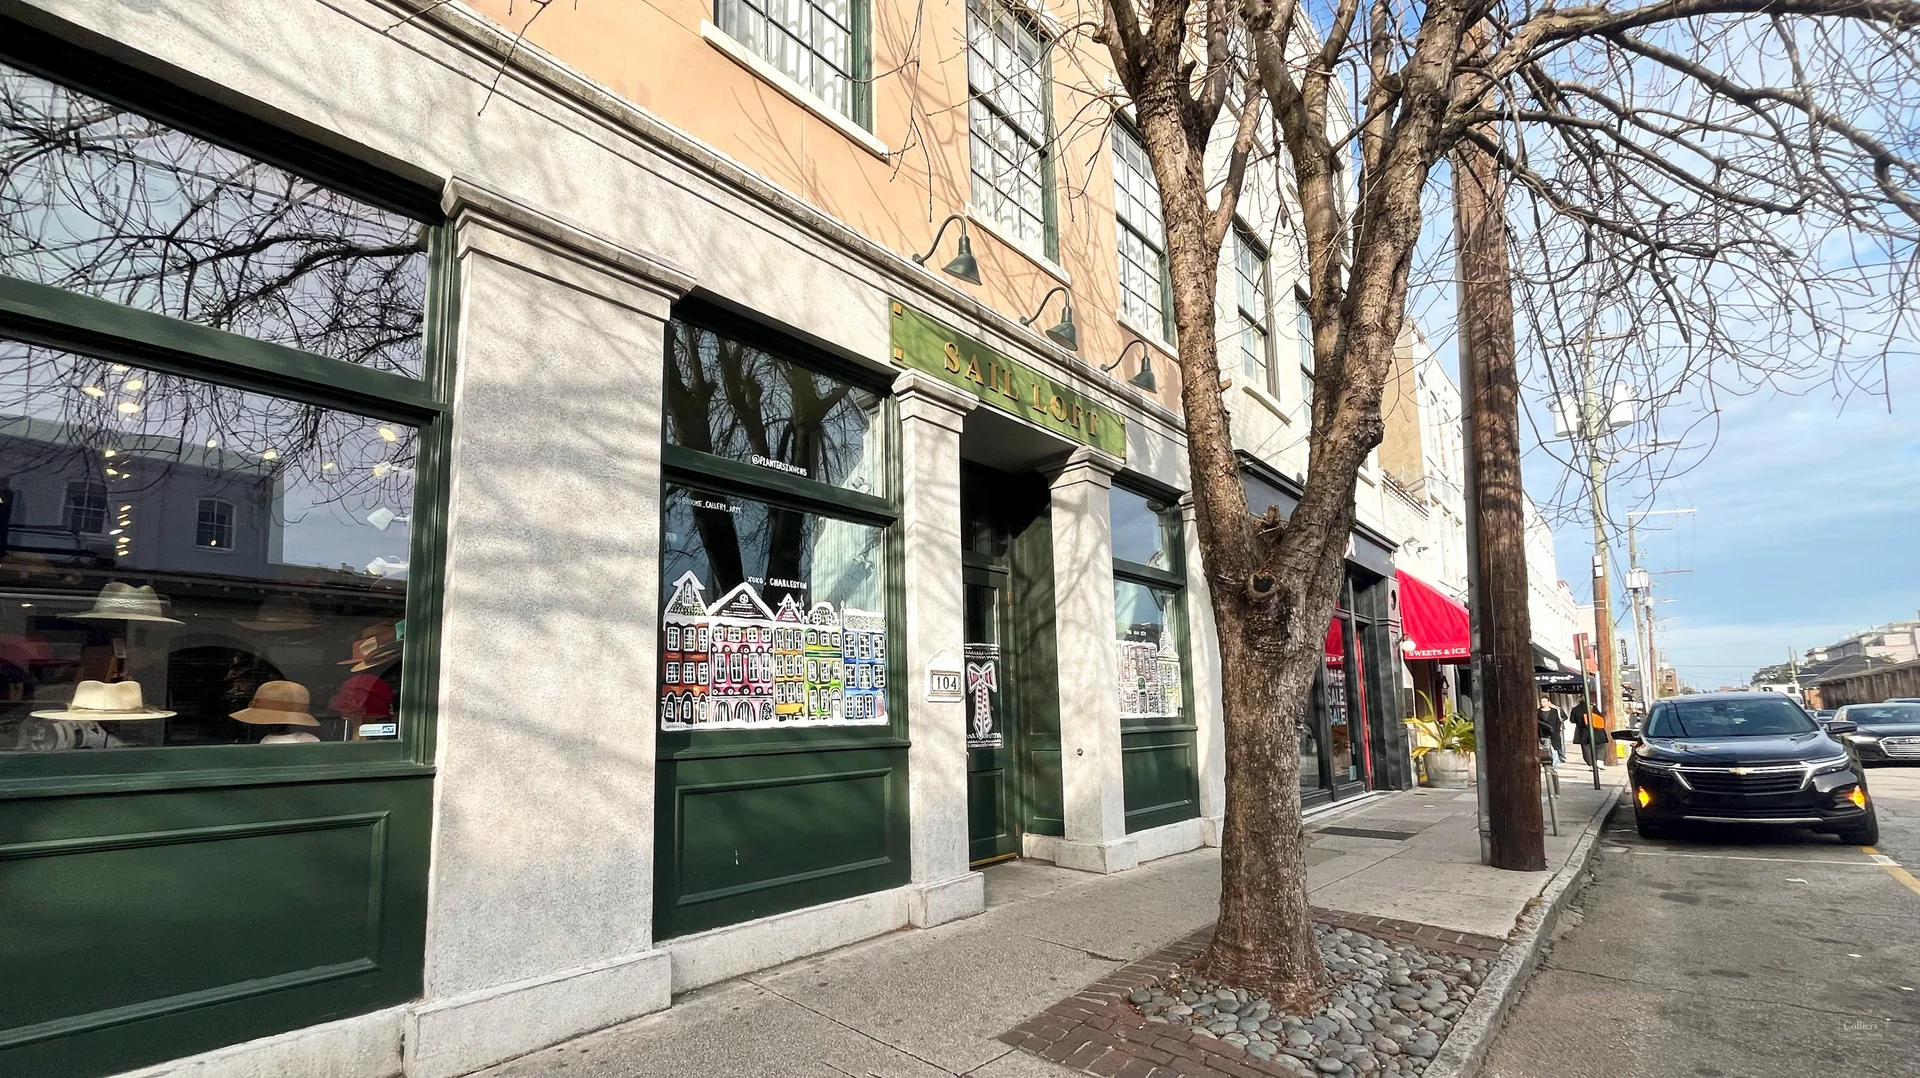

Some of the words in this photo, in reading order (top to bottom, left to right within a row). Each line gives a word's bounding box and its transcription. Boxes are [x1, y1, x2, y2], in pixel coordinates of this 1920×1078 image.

[944, 341, 1019, 401] SAIL
[1032, 384, 1099, 436] LOFT
[769, 577, 807, 590] CHARLESTON
[1408, 649, 1442, 657] SWEETS
[937, 676, 957, 690] 104
